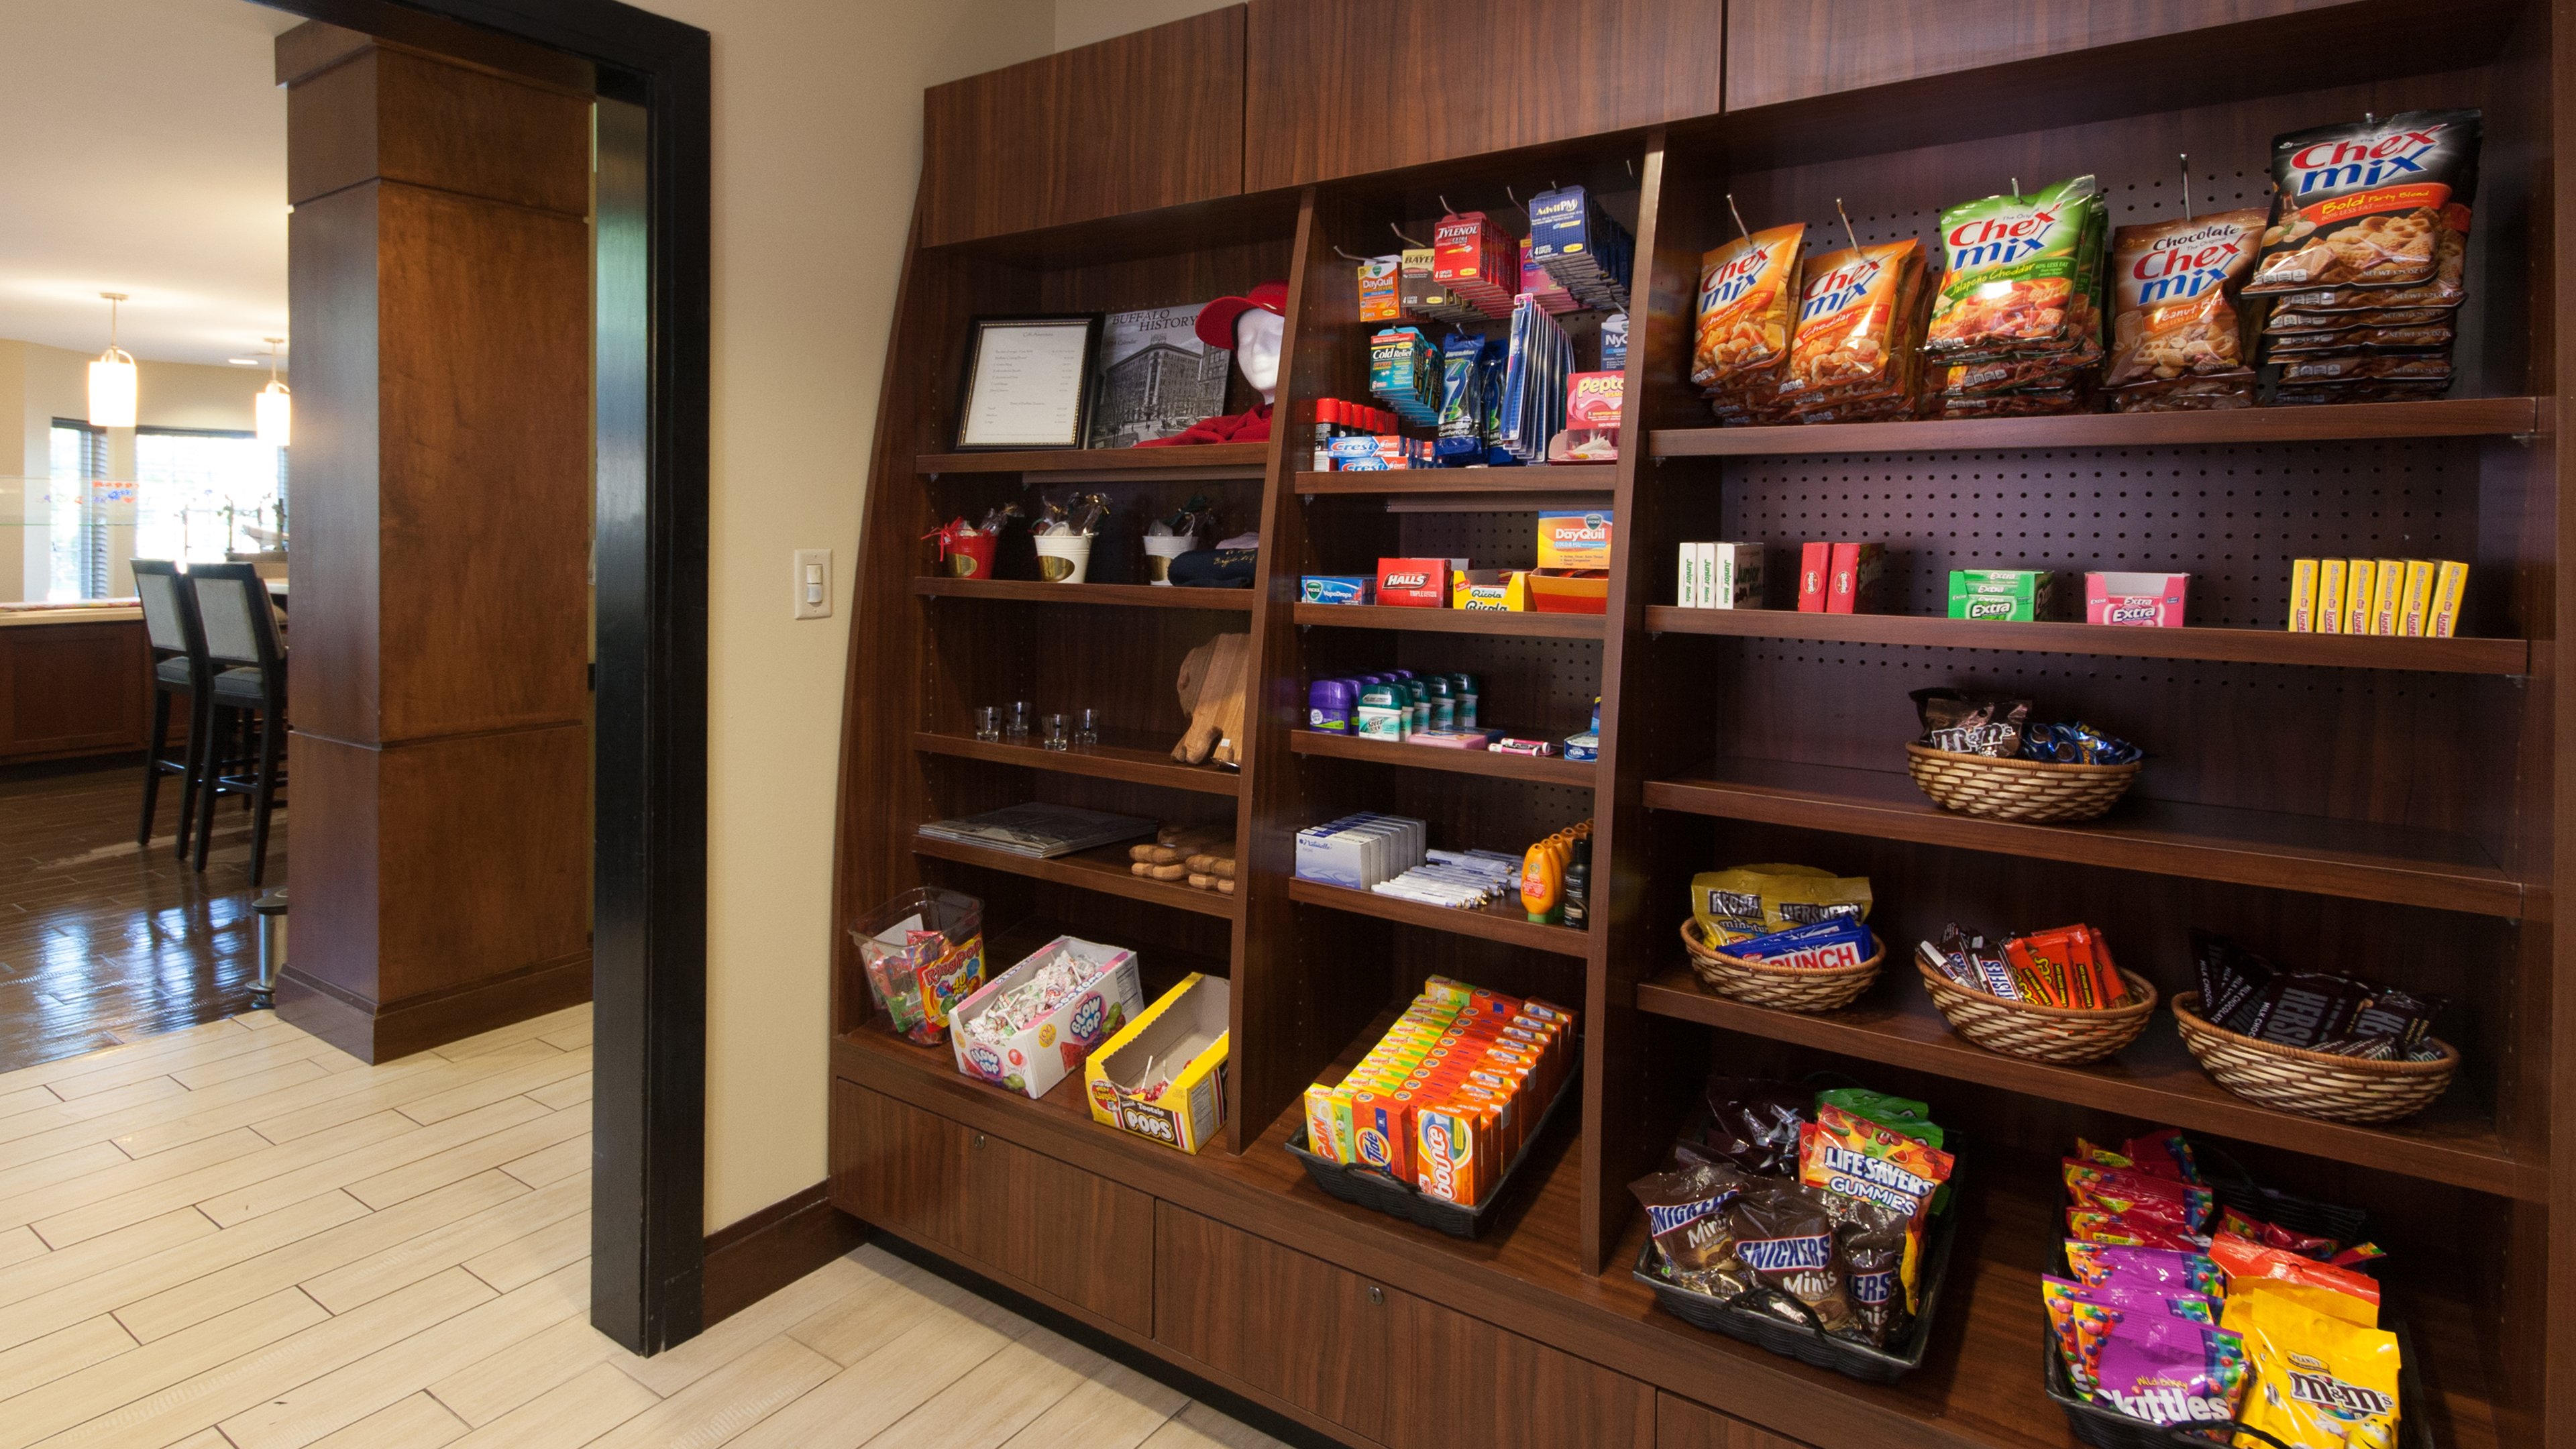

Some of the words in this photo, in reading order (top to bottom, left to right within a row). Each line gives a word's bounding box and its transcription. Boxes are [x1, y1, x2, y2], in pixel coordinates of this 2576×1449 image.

[2291, 124, 2448, 169] Chex
[2299, 145, 2436, 195] mix
[1536, 204, 1560, 216] Advil
[1560, 199, 1578, 211] PM
[2322, 195, 2365, 214] Bold
[2399, 191, 2429, 199] Blend
[2339, 208, 2357, 216] LESS
[1437, 225, 1478, 239] TYLENOL
[1949, 202, 2063, 246] Chex
[1953, 222, 2055, 270] mix
[2153, 225, 2240, 252] Chocolate
[1702, 241, 1774, 293] Chex
[2133, 232, 2248, 280] Chex
[1803, 250, 1896, 301] Chex
[1989, 262, 2037, 280] Cheddar
[2137, 253, 2239, 305] mix
[1363, 276, 1393, 289] DayQuil
[1701, 262, 1768, 314] mix
[1802, 270, 1879, 322] mix
[1112, 309, 1170, 325] BUFFALO
[1139, 315, 1198, 331] HISTORY
[1703, 301, 1745, 330] Cheddar
[1803, 311, 1854, 339] Cheddar
[1373, 347, 1394, 360] Cold
[1394, 349, 1413, 358] Relief
[1331, 441, 1376, 451] Crest
[1342, 463, 1385, 472] Crest
[1556, 528, 1605, 542] DayQuil
[1387, 574, 1426, 586] HALLS
[1990, 572, 2017, 580] Extra
[1471, 589, 1503, 598] Ricola
[1978, 585, 2004, 593] Extra
[1465, 600, 1508, 611] Ricola
[1972, 602, 2011, 617] Extra
[2123, 597, 2153, 606] Extra
[2112, 607, 2156, 623] Extra
[2298, 610, 2307, 632] RAISINE
[2326, 612, 2334, 633] RAISINE
[2354, 612, 2363, 634] RAISINE
[2381, 613, 2390, 635] RAISINE
[2410, 614, 2419, 635] RAISINE
[2439, 614, 2450, 636] RAISINE
[1713, 893, 1763, 918] HERSH
[1770, 946, 1856, 968] UNCH
[2200, 959, 2208, 977] MILK
[1982, 960, 2017, 1000] TISFIES
[2239, 983, 2253, 998] MILK
[1071, 995, 1102, 1034] BLOW
[2210, 994, 2241, 1024] CHOCOLATE
[2259, 1001, 2272, 1018] MILK
[2261, 987, 2328, 1046] HERSH
[1081, 1011, 1103, 1040] POP
[970, 1048, 1000, 1065] BLOW
[981, 1060, 1000, 1076] POP
[1137, 1102, 1165, 1117] Tootsie
[1126, 1110, 1173, 1140] POPS
[1364, 1130, 1386, 1165] Tide
[1430, 1128, 1456, 1200] bounce
[1825, 1148, 1865, 1173] LIFE
[1864, 1155, 1935, 1197] SAVERS
[1829, 1177, 1919, 1216] GUMMIES
[1737, 1234, 1831, 1270] SNICKERS
[1783, 1271, 1837, 1296] Minis
[2292, 1353, 2321, 1367] PEANUT
